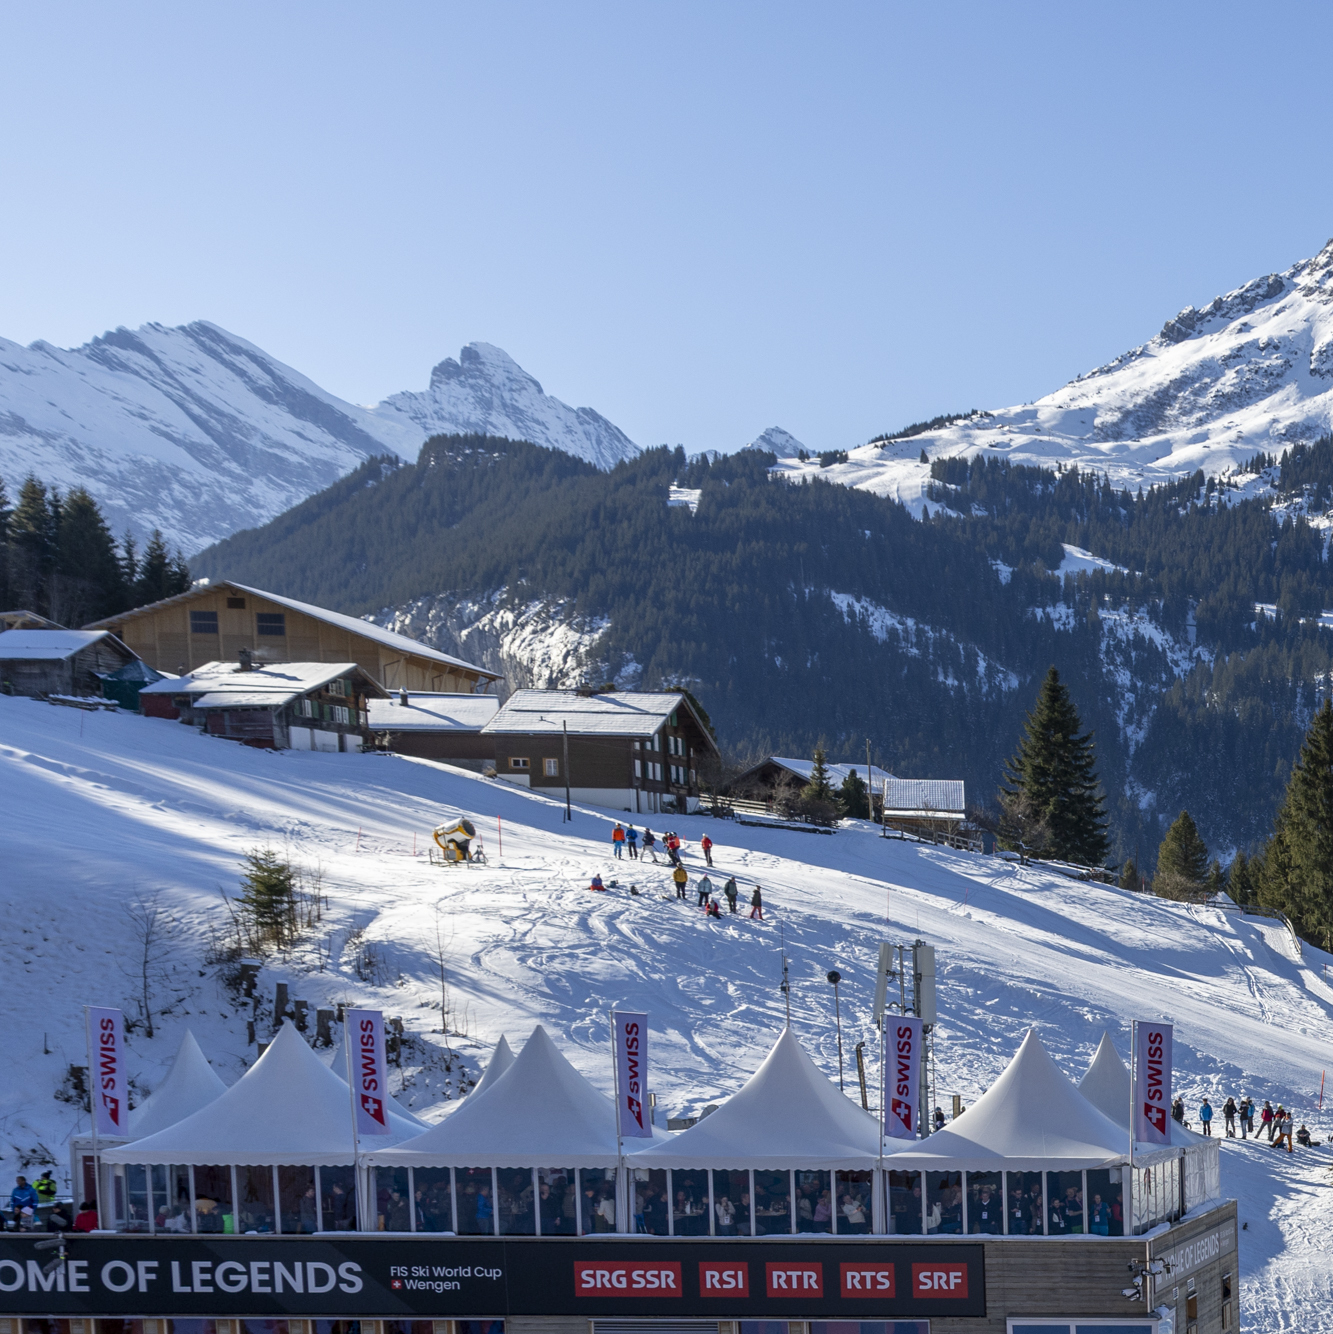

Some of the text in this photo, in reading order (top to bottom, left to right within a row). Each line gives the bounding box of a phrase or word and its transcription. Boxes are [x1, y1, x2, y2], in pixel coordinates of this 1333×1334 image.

[100, 1018, 116, 1091] SWISS
[360, 1019, 379, 1092] SWISS
[627, 1022, 640, 1094] SWISS
[897, 1026, 913, 1098] SWISS
[1147, 1031, 1164, 1102] SWISS
[1194, 1232, 1219, 1264] LEGENDS
[101, 1260, 159, 1293] OF
[171, 1261, 363, 1293] LEGENDS
[390, 1265, 502, 1281] FIS Ski World Cup
[404, 1278, 460, 1293] Wengen
[581, 1270, 675, 1289] SRG SSR
[705, 1270, 743, 1289] RSI
[772, 1270, 818, 1289] RTR
[846, 1271, 890, 1290] RTS
[918, 1271, 962, 1290] SRF
